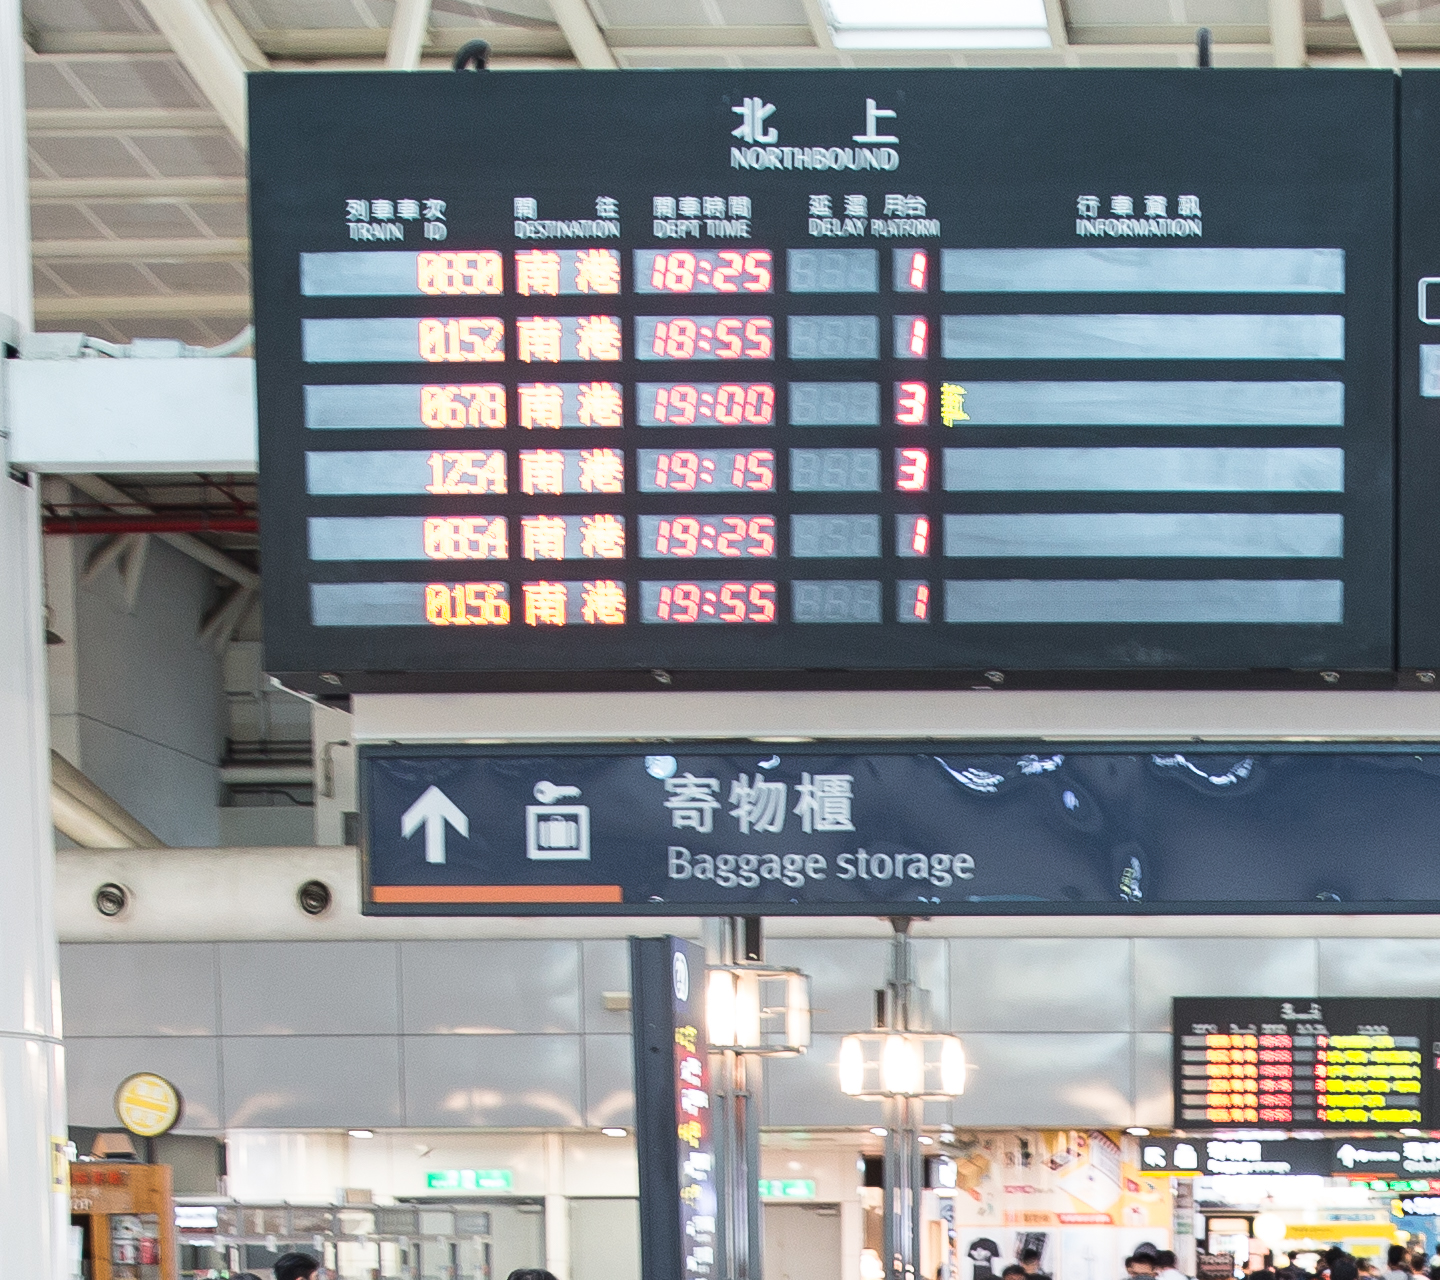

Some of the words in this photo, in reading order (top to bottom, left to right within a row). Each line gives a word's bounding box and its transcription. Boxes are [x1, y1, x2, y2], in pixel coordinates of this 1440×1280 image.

[731, 97, 900, 145] 北上
[730, 147, 900, 172] NORTHBOUND
[884, 194, 927, 217] 月台
[346, 222, 404, 241] TRAIN
[424, 222, 447, 241] ID
[514, 220, 620, 239] DESTINATION
[653, 219, 702, 239] DEPT
[703, 219, 751, 238] TIME
[809, 218, 868, 237] DELAY
[870, 219, 940, 238] PLATFORM
[1076, 218, 1202, 237] INFORMATION
[515, 249, 621, 295] 南港
[651, 252, 771, 292] 18:25
[909, 253, 926, 291] 1
[418, 318, 505, 362] 0152
[516, 315, 621, 363] 南港
[652, 319, 773, 359] 18:55
[910, 319, 926, 356] 1
[420, 385, 507, 428] 0678
[517, 382, 622, 429] 南港
[654, 383, 774, 426] 19:00
[896, 382, 927, 424] 3
[425, 451, 508, 494] 1254
[519, 449, 624, 495] 南港
[655, 450, 774, 489] 19:15
[898, 451, 928, 491] 3
[521, 514, 625, 560] 南港
[657, 516, 776, 556] 19:25
[912, 519, 928, 554] 1
[425, 583, 510, 625] 0156
[521, 580, 626, 626] 南港
[657, 583, 776, 623] 19:55
[913, 585, 928, 621] 1
[663, 772, 857, 834] 寄物櫃
[667, 845, 827, 888] Baggage
[835, 846, 977, 888] storage
